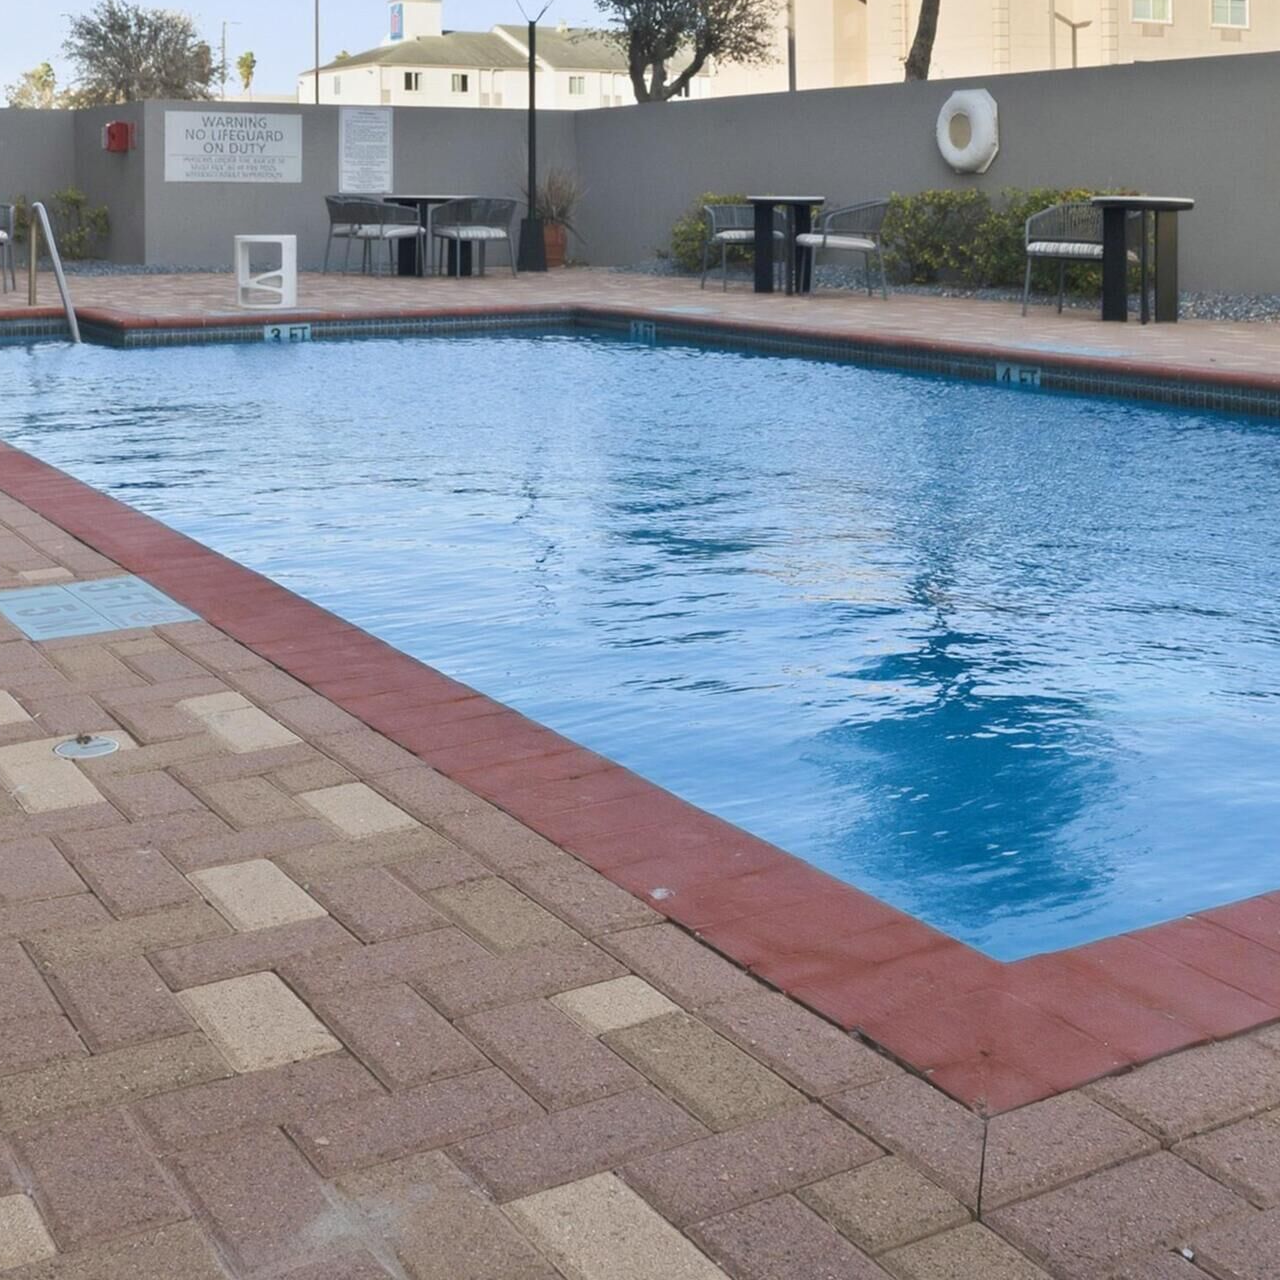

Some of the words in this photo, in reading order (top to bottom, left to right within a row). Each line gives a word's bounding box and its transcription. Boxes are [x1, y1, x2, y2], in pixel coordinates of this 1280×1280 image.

[201, 116, 267, 129] WARNING
[185, 129, 206, 140] NO
[211, 130, 284, 142] LIFEGUARD
[203, 142, 224, 154] ON
[229, 143, 266, 154] DUTY
[289, 326, 308, 341] FT
